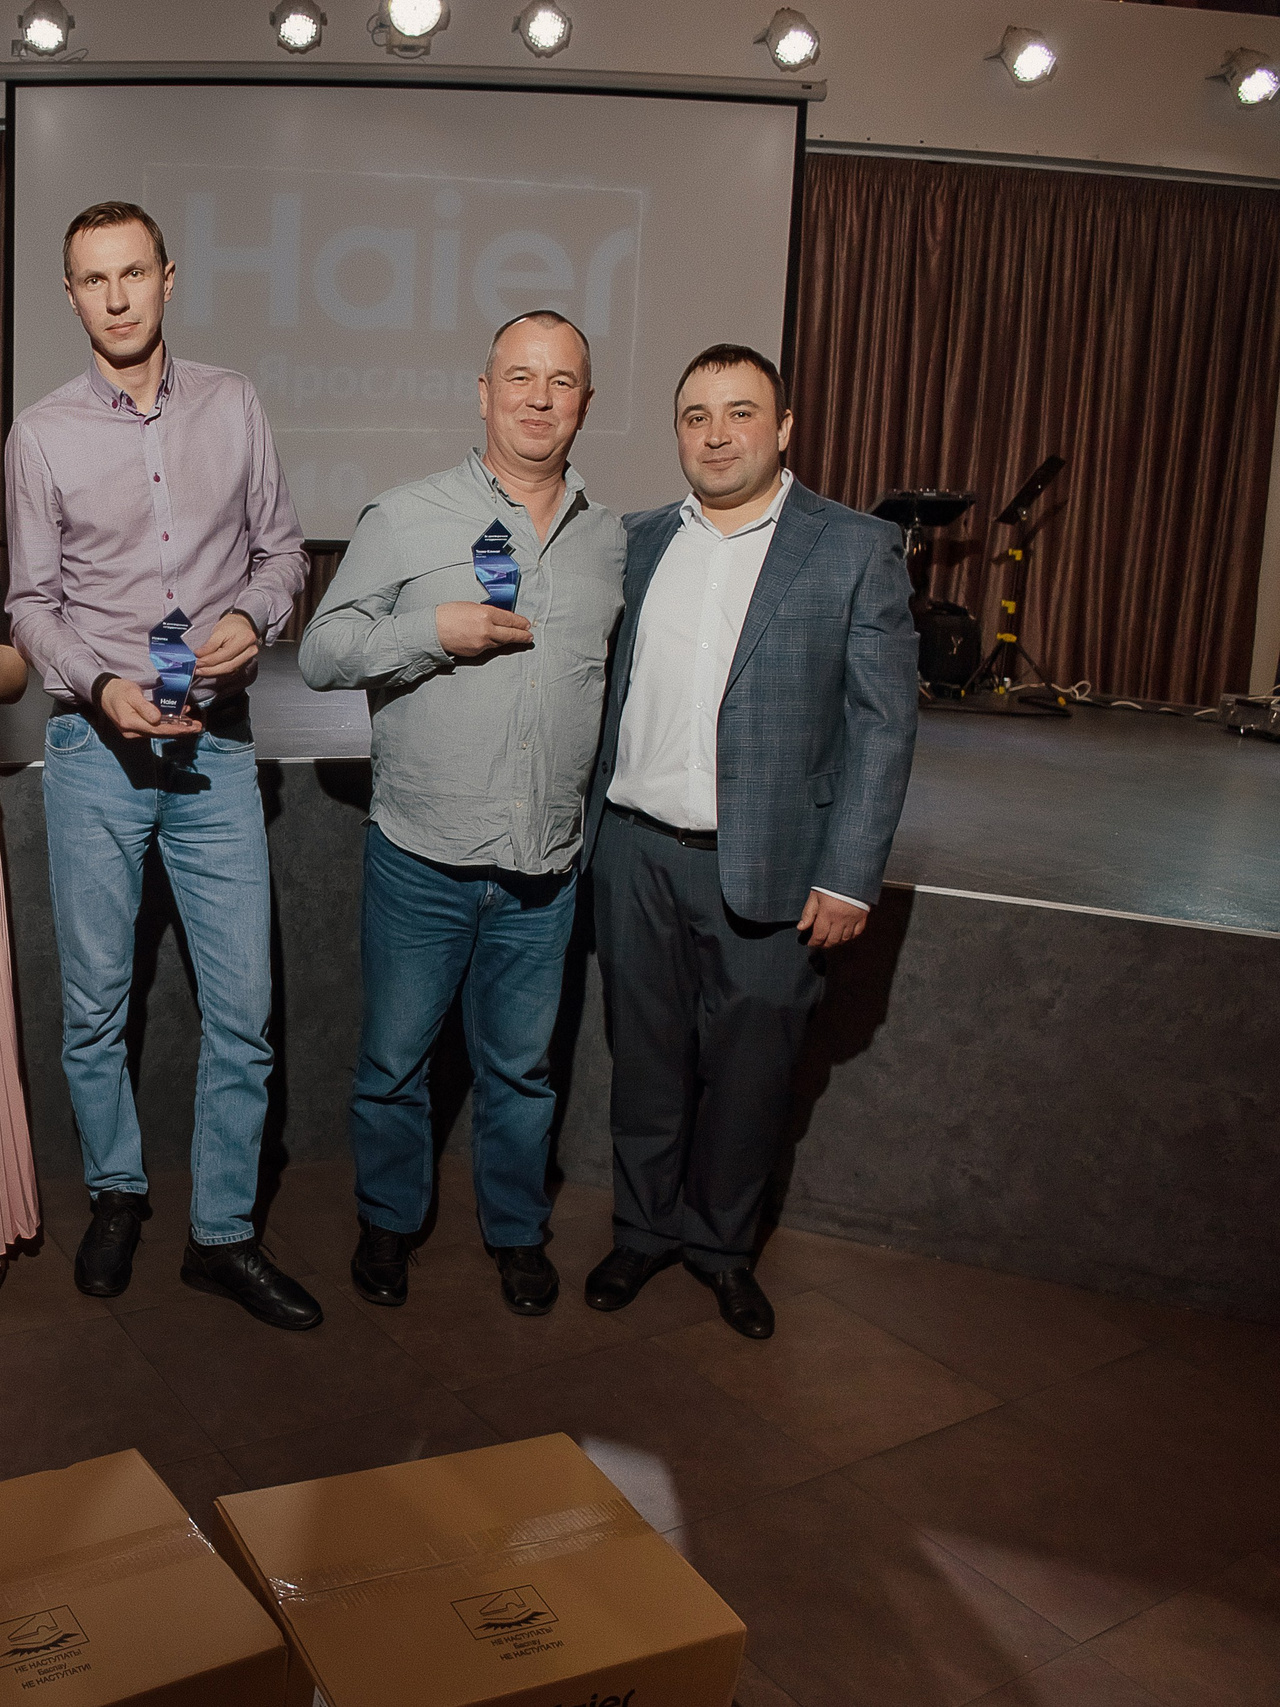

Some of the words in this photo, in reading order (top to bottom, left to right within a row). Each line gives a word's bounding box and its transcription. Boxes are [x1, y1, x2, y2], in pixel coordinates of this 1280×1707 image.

[182, 188, 640, 338] Haier
[257, 354, 481, 408] Ярослав
[15, 1664, 28, 1673] НЕ
[29, 1649, 82, 1669] НАСТУПАТЬ!
[500, 1653, 513, 1661] НЕ
[37, 1662, 67, 1676] Баспау
[22, 1680, 35, 1689] НЕ
